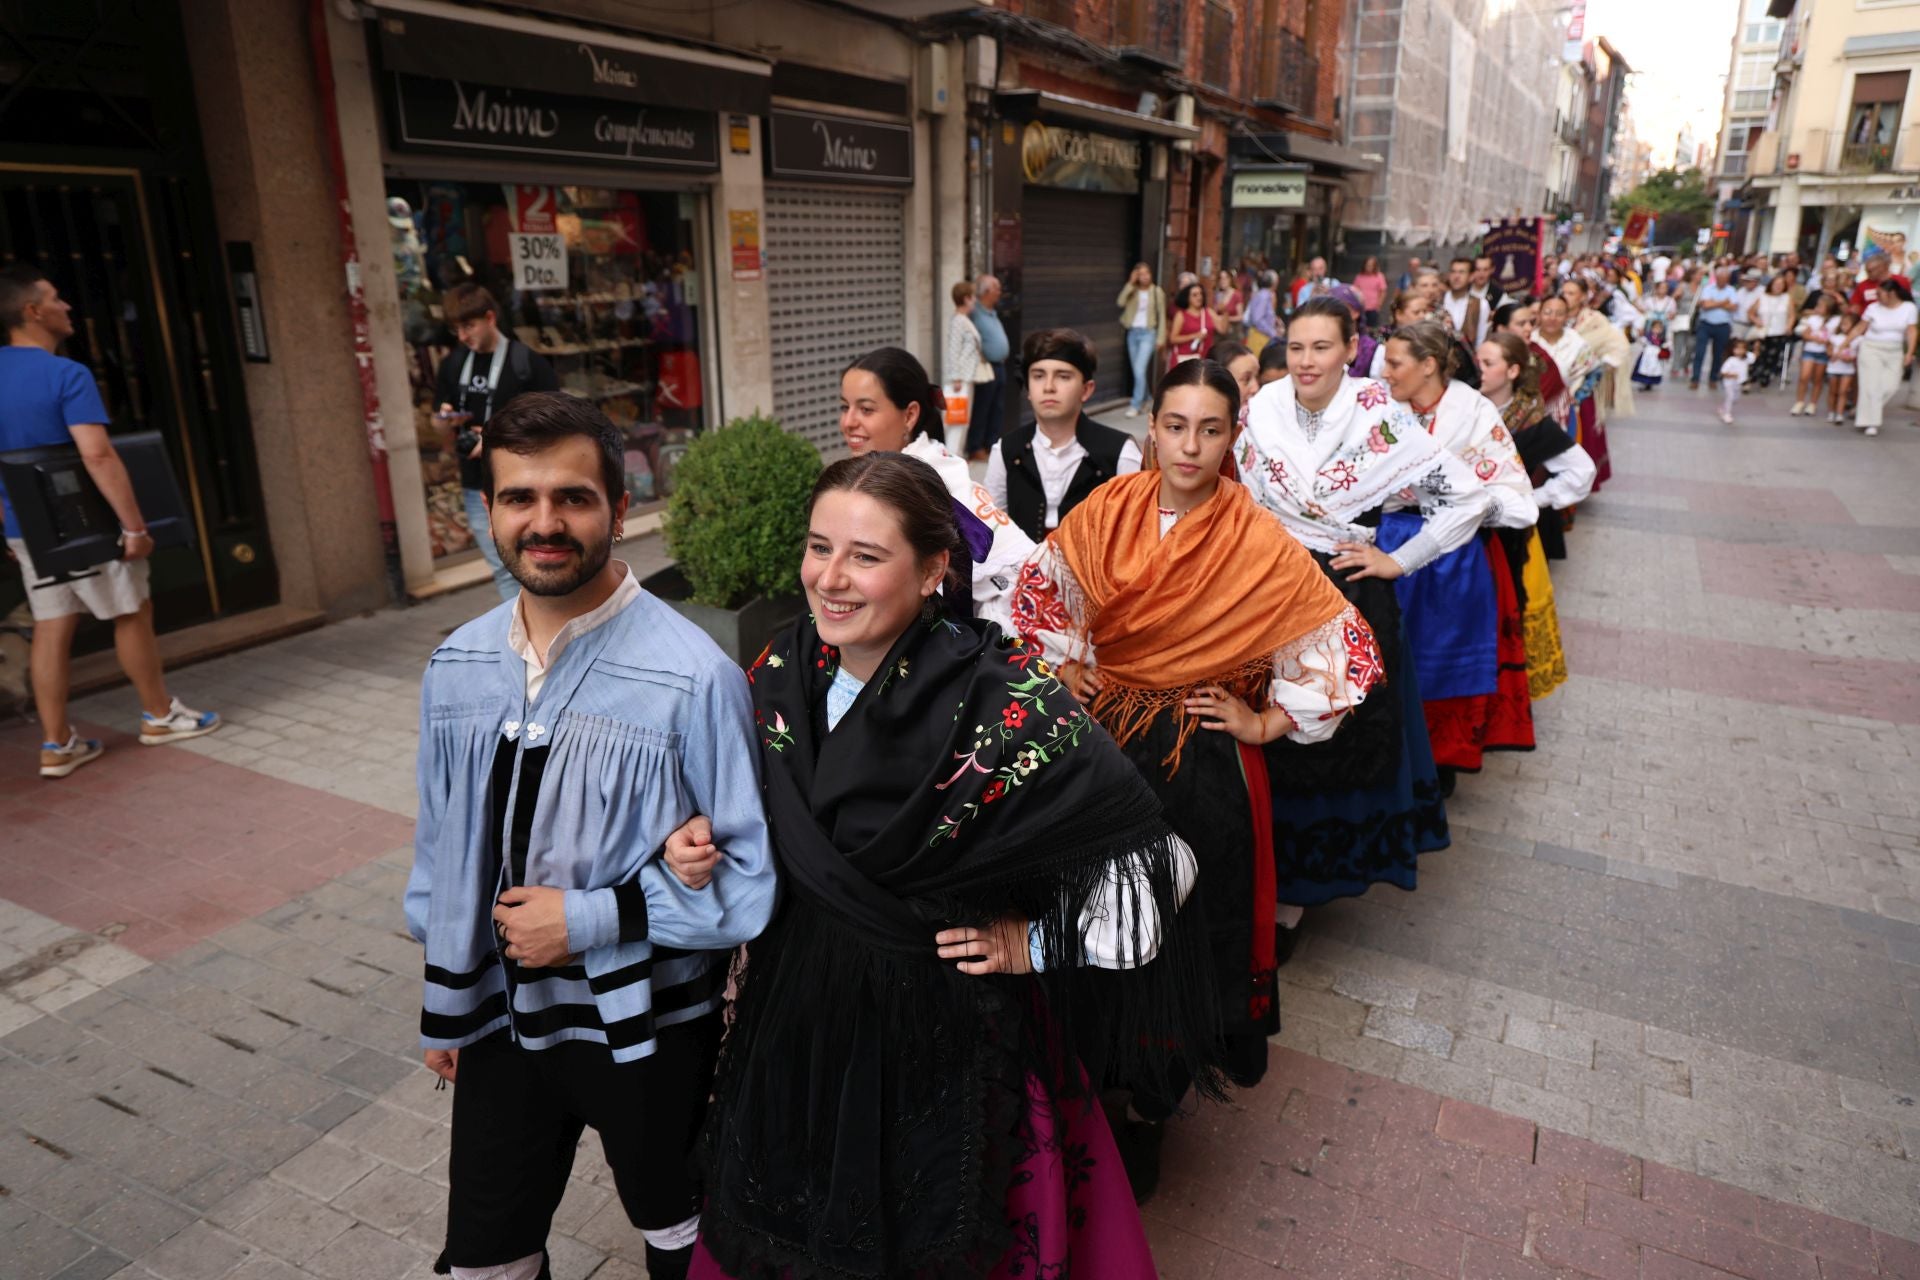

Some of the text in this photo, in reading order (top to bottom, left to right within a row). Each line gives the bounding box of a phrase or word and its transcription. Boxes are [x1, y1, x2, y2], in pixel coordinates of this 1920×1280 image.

[578, 44, 638, 88] Moiva
[453, 80, 559, 138] Moiva
[594, 109, 695, 157] Complementos
[812, 119, 878, 171] Moiva
[518, 236, 560, 260] 30%
